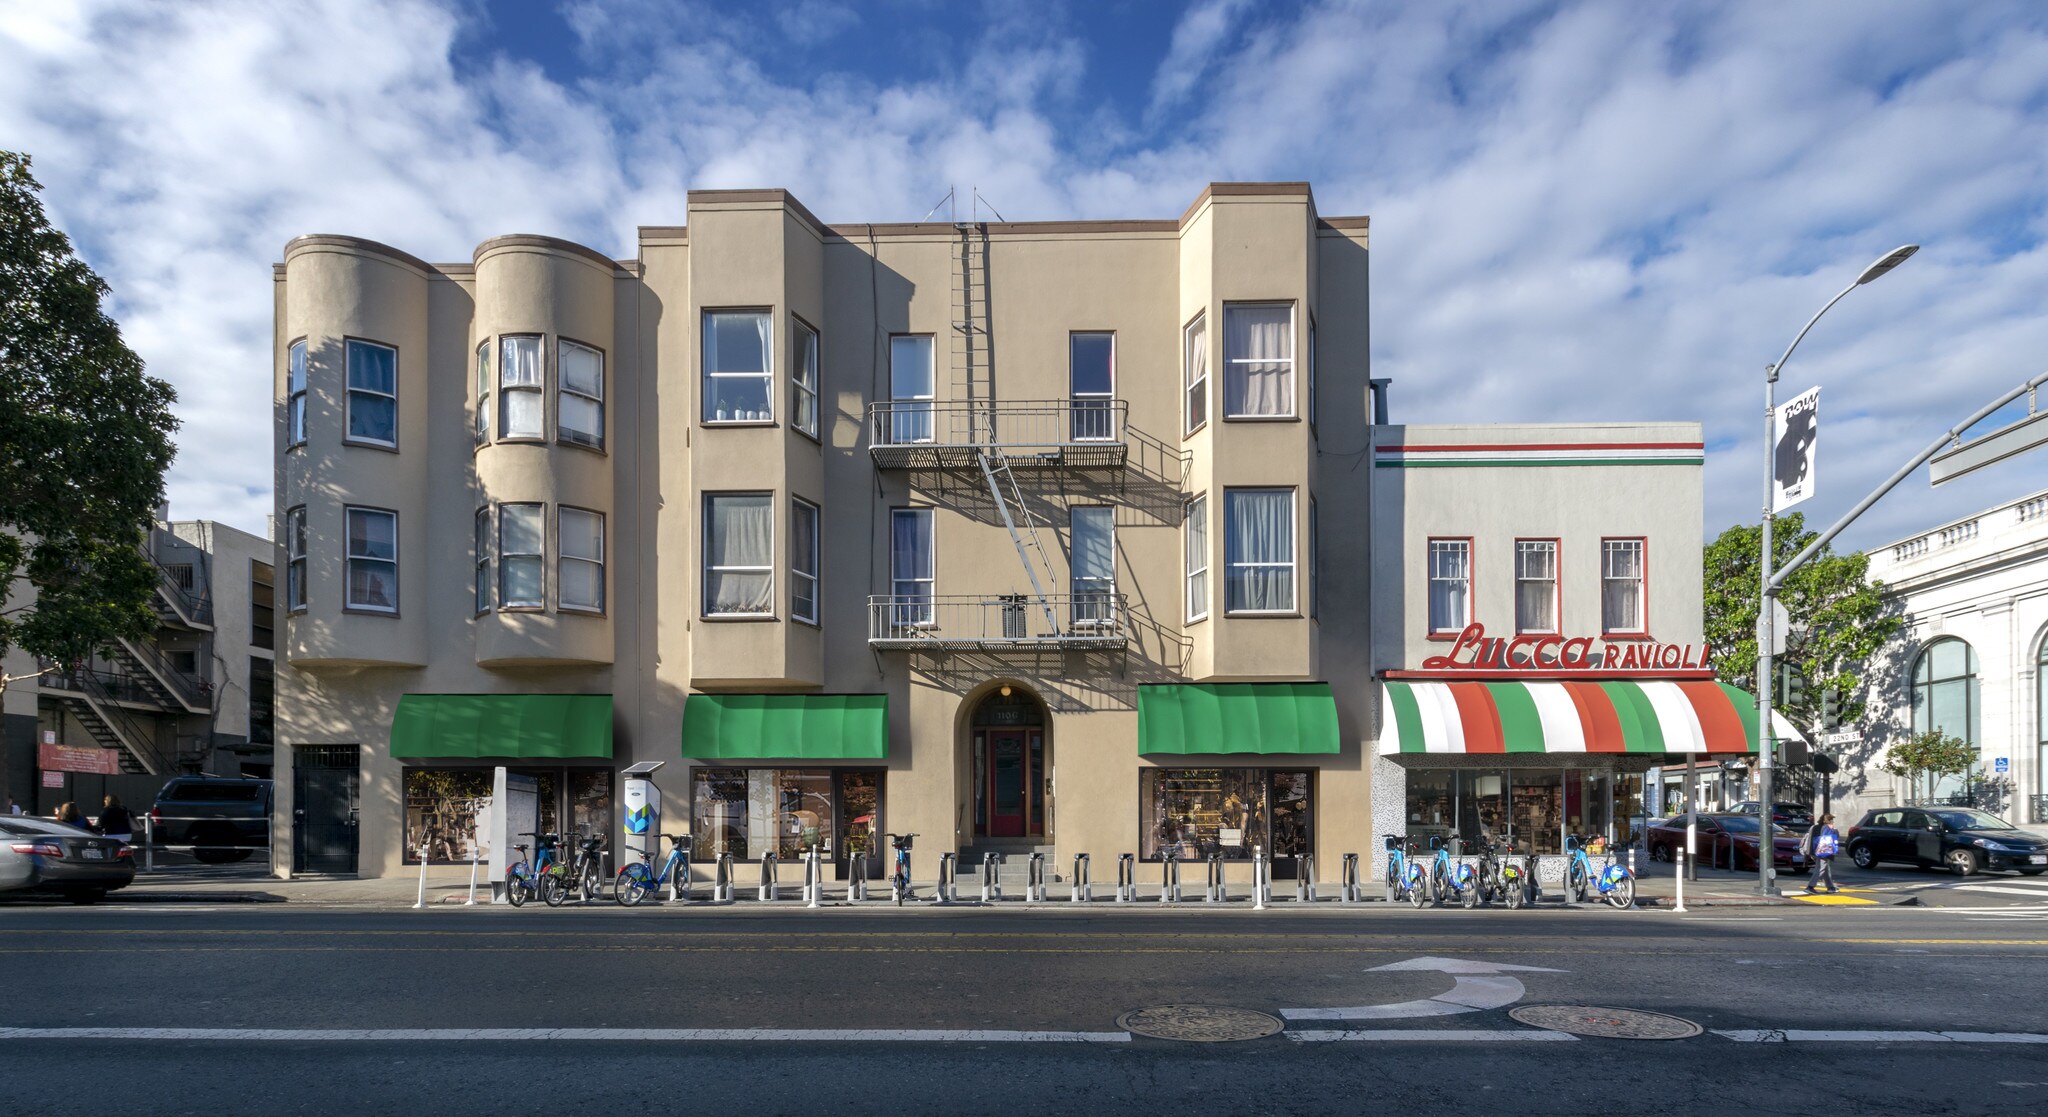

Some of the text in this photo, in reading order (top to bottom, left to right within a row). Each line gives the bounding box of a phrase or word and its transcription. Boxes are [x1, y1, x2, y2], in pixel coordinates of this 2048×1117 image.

[1421, 622, 1710, 669] Lucca RAVIOLI
[1833, 732, 1859, 742] 22ND ST
